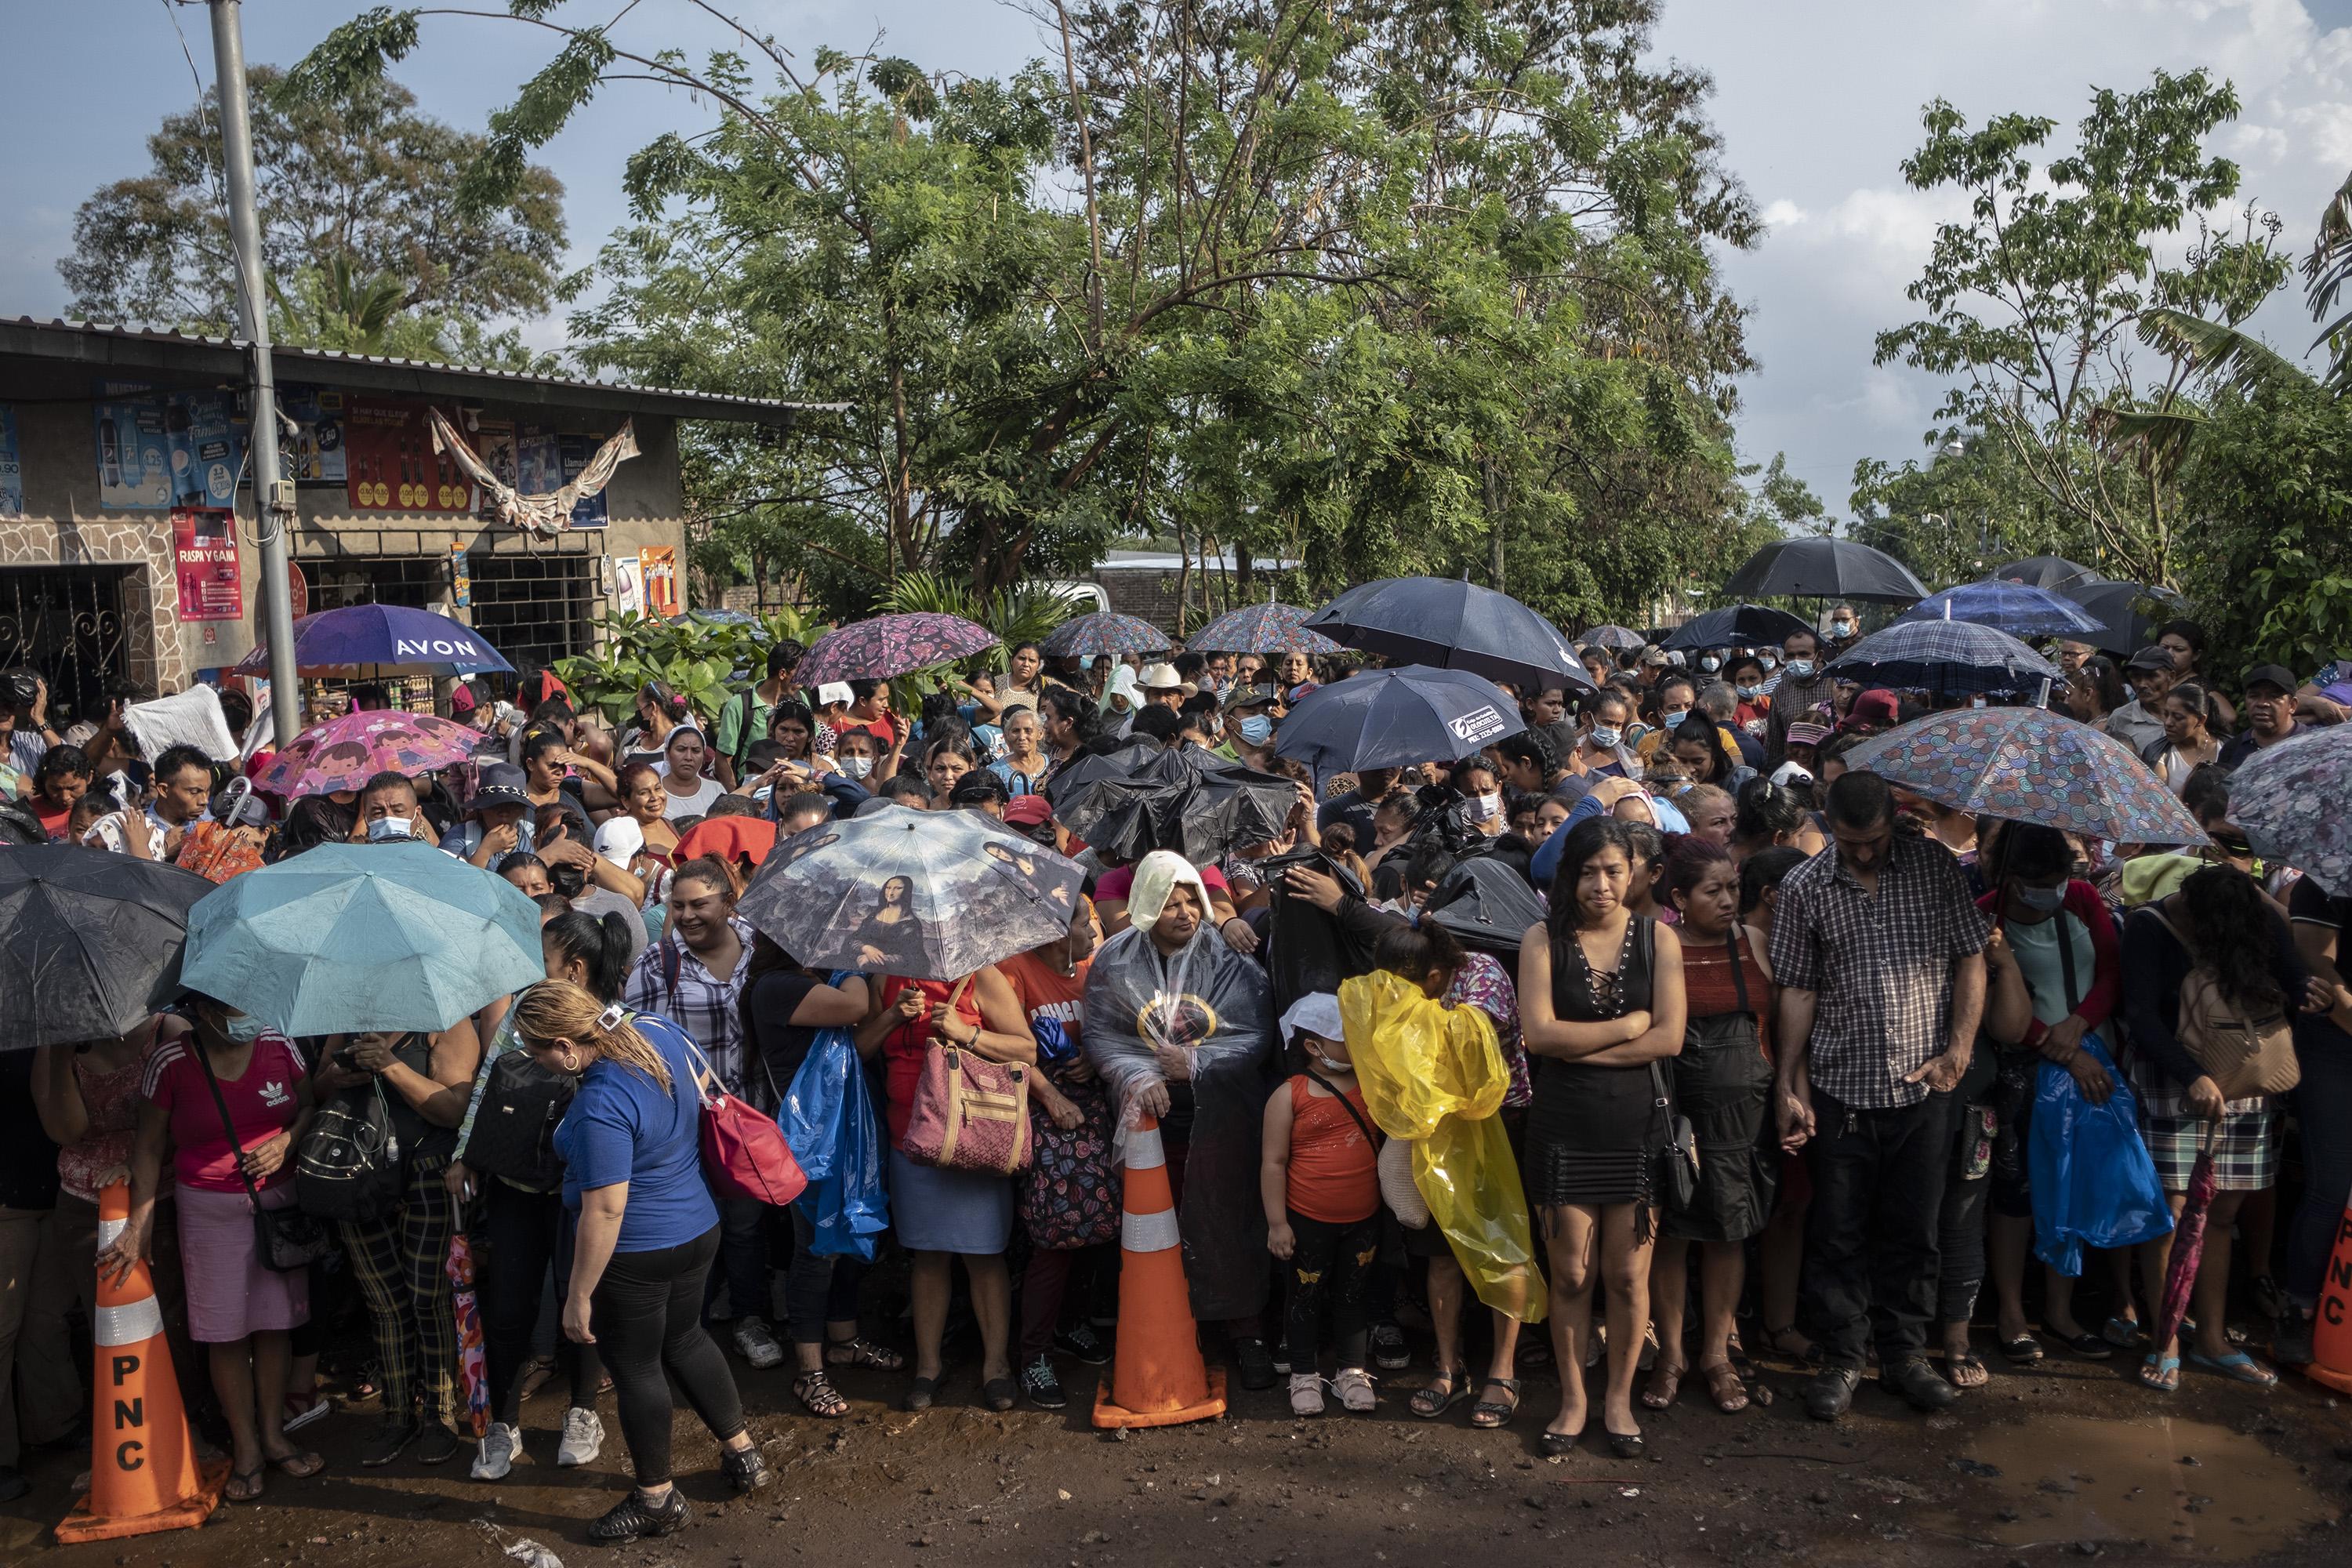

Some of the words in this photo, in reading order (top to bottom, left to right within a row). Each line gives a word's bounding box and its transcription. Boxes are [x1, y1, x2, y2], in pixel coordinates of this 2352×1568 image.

[187, 419, 227, 442] Familia
[0, 463, 19, 474] .90
[180, 550, 204, 562] RASPA
[205, 550, 212, 562] Y
[213, 550, 235, 562] GANA
[397, 639, 477, 656] AVON
[267, 1094, 289, 1106] adidas
[113, 1355, 144, 1471] PNC
